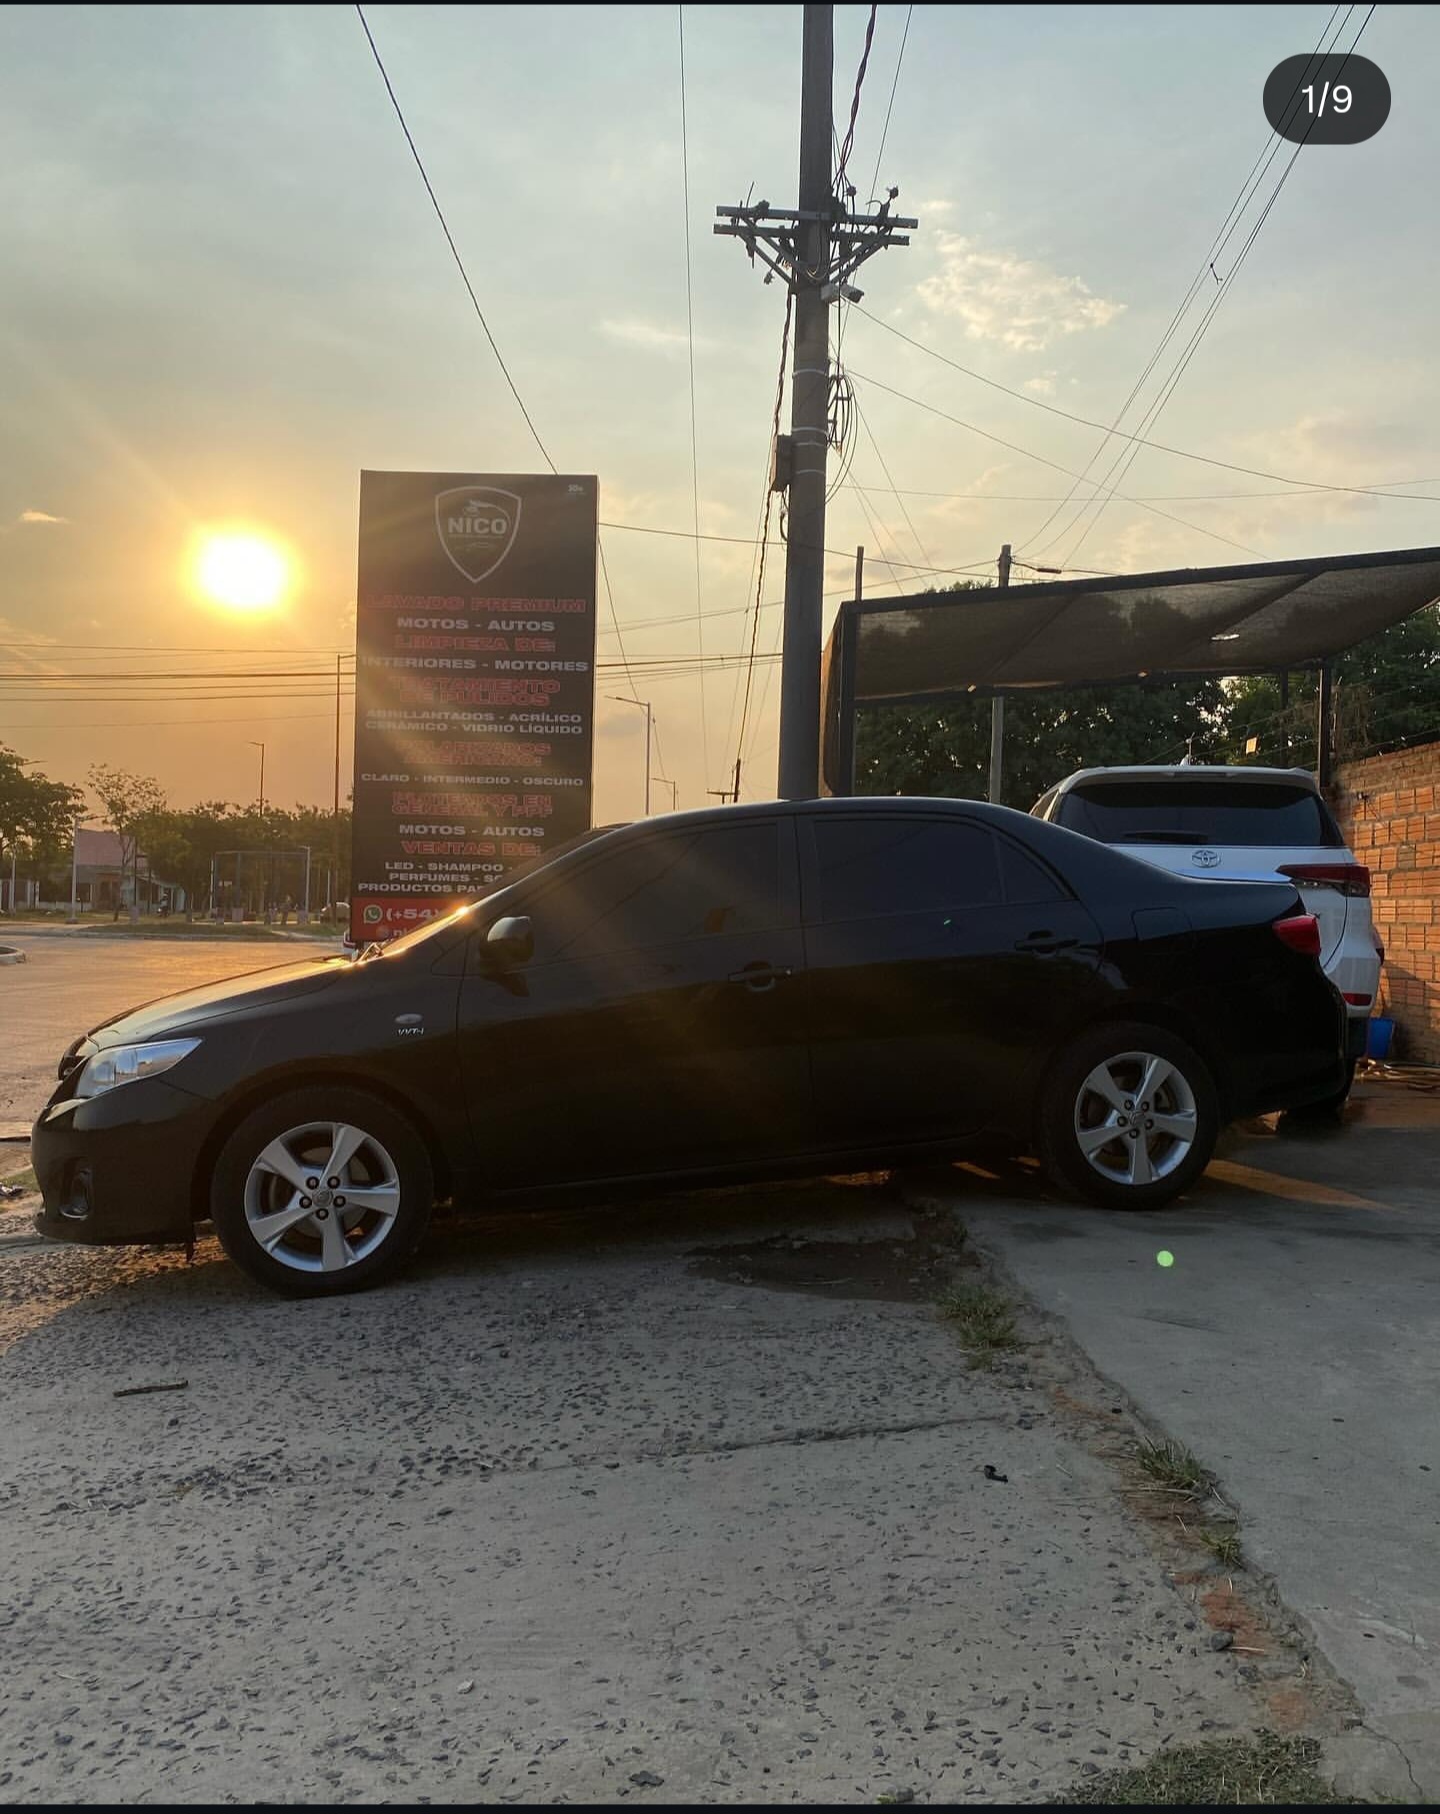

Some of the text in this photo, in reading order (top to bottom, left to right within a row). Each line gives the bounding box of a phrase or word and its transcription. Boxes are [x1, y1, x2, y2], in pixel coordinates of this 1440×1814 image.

[447, 517, 507, 534] NICO
[367, 595, 586, 613] LAVADO PREMIUM
[397, 617, 468, 629] MOTOS
[488, 619, 555, 632] AUTOS
[393, 634, 556, 652] LIMPIEZA DE:
[362, 656, 476, 669] INTERIORES
[494, 659, 588, 672] MOTORES
[440, 691, 551, 706] PULIDOS
[366, 709, 494, 722] ABRILLANTADOS
[509, 711, 582, 723] ACRÍLICO
[462, 723, 515, 733] VIDRIO
[519, 723, 583, 734] LÍQUIDO
[361, 773, 410, 783] CLARO
[423, 774, 510, 785] INTERMEDIO
[523, 776, 584, 787] OSCURO
[524, 793, 552, 806] EN
[391, 803, 488, 816] GENERAL
[491, 804, 507, 817] Y
[399, 823, 466, 835] MOTOS
[482, 826, 545, 837] AUTOS
[400, 839, 495, 855] VENTAS
[385, 861, 414, 870] LED
[428, 862, 504, 872] SHAMPOO
[389, 872, 470, 883] PERFUMES
[358, 882, 453, 893] PRODUCTOS
